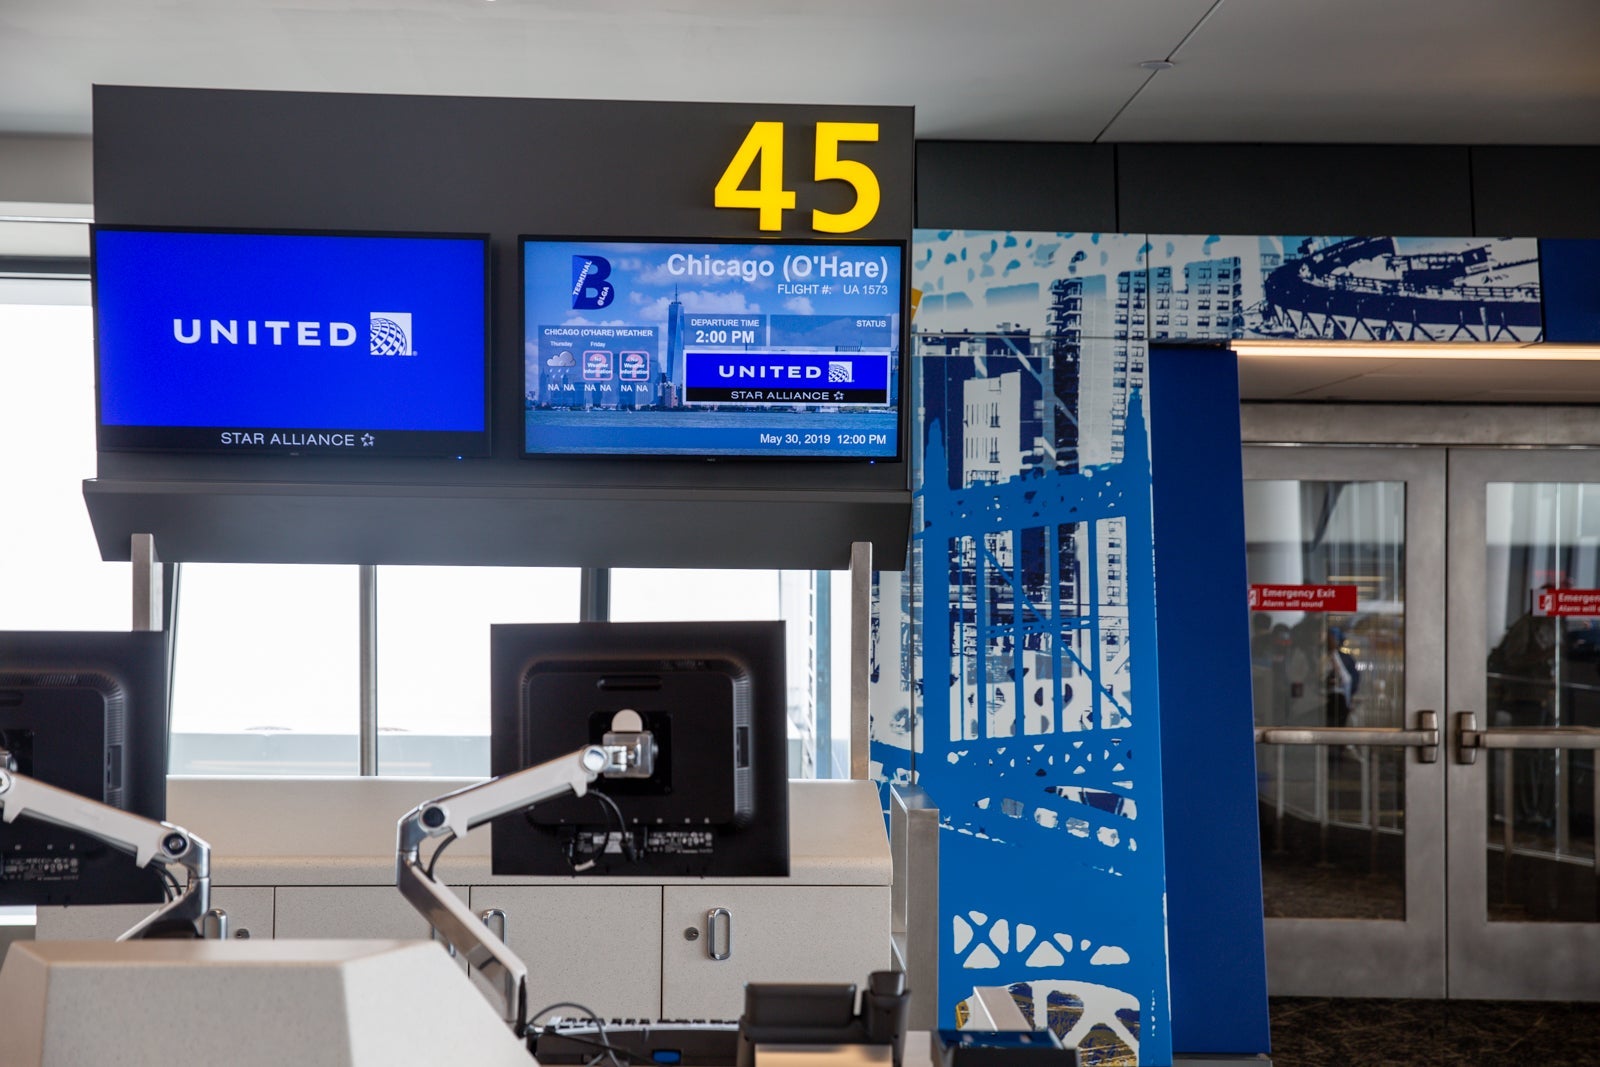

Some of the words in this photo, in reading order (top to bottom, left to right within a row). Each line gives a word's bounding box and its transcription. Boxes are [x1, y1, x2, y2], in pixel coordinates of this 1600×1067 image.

[714, 121, 881, 234] 45
[667, 253, 775, 282] Chicago
[783, 255, 889, 283] (O'Hare)
[573, 260, 593, 296] TERMINAL
[777, 284, 819, 295] FLIGHT
[822, 285, 832, 295] #:
[843, 285, 860, 295] UA
[862, 285, 888, 295] 1573
[691, 318, 739, 328] DEPARTURE
[741, 319, 760, 328] TIME
[856, 319, 887, 329] STATUS
[173, 318, 358, 347] UNITED
[544, 328, 580, 337] CHICAGO
[581, 328, 615, 338] (O'HARE)
[616, 329, 653, 337] WEATHER
[695, 330, 727, 344] 2:00
[731, 331, 755, 344] PM
[719, 365, 822, 379] UNITED
[584, 384, 596, 392] NA
[599, 384, 612, 392] NA
[620, 384, 633, 392] NA
[636, 384, 648, 392] NA
[731, 391, 763, 400] STAR
[767, 391, 830, 401] ALLIANCE
[220, 431, 265, 445] STAR
[270, 433, 355, 447] ALLIANCE
[760, 433, 783, 446] May
[785, 434, 802, 446] 30,
[804, 434, 831, 444] 2019
[837, 435, 866, 444] 12:00
[868, 435, 887, 445] PM
[1262, 587, 1315, 599] Emergency
[1316, 588, 1336, 599] Exit
[1262, 600, 1285, 608] Alarm
[1285, 600, 1300, 608] will
[1301, 600, 1324, 609] sound
[1558, 605, 1581, 613] Alarm
[1582, 605, 1597, 613] will
